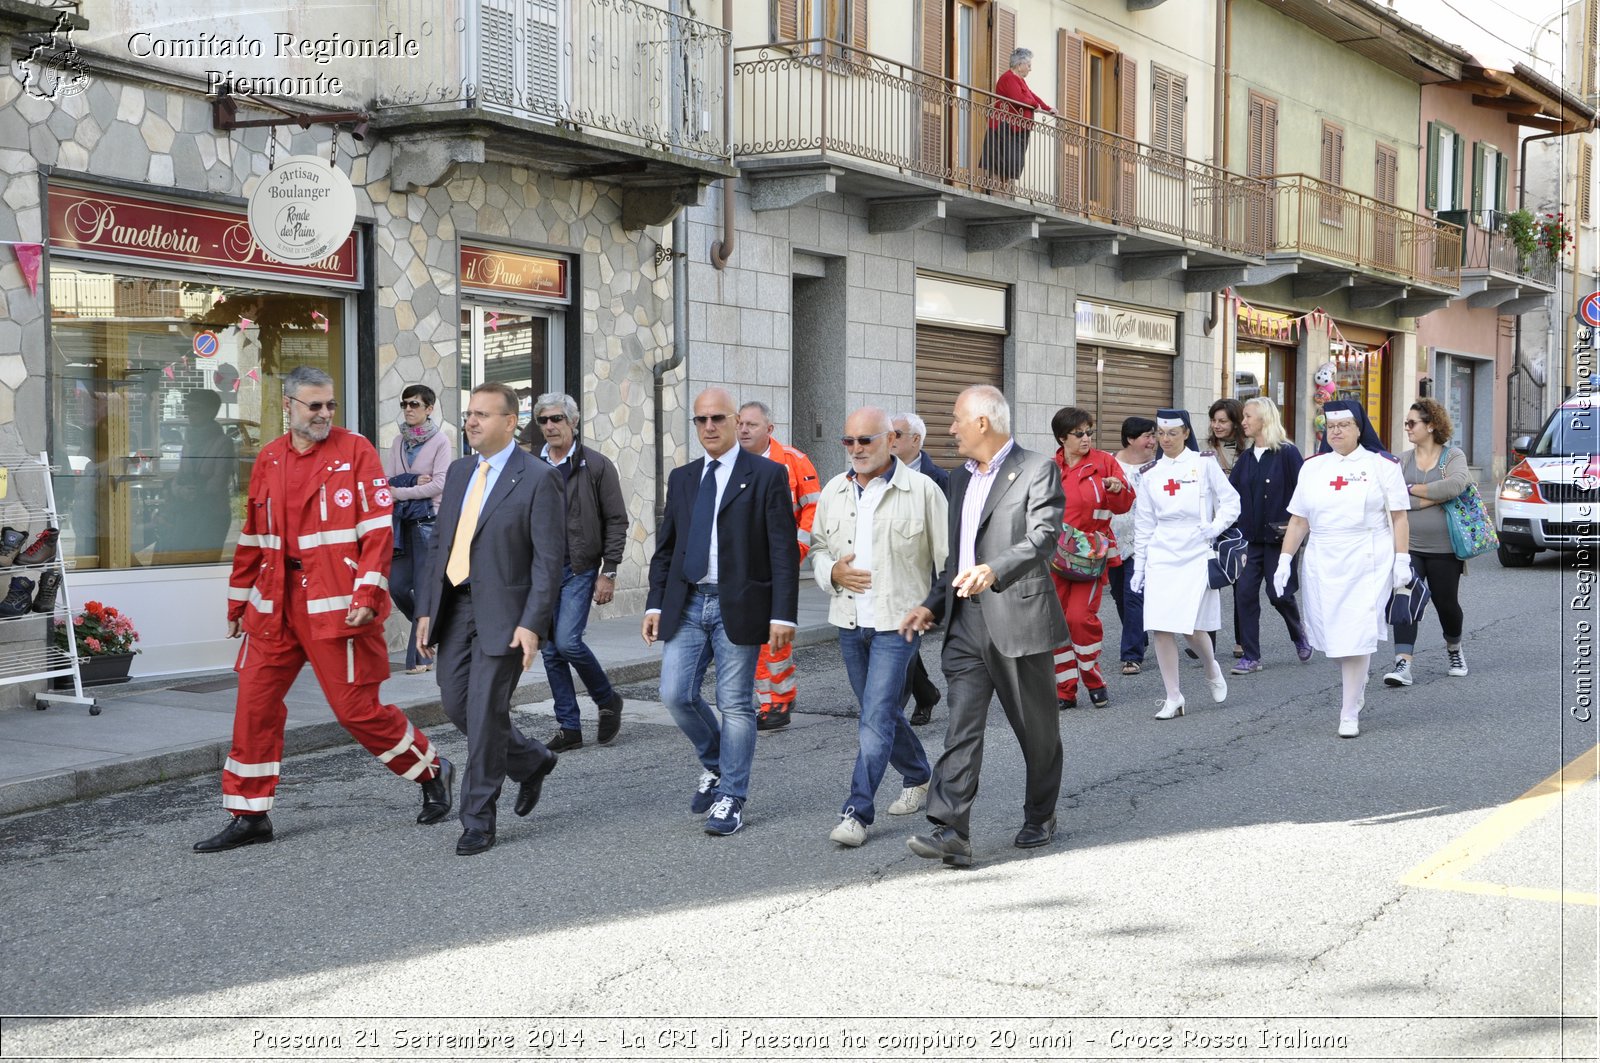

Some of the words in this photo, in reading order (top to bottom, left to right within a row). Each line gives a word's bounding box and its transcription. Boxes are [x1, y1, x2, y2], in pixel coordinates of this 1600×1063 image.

[279, 166, 320, 185] Artisan
[268, 184, 330, 201] Boulanger
[286, 205, 310, 224] Ronde
[65, 198, 201, 255] Panetteria
[280, 224, 294, 238] des
[292, 221, 316, 241] Pains
[466, 257, 476, 280] il
[478, 254, 522, 286] Pane
[1137, 320, 1172, 343] OROLOGERIA
